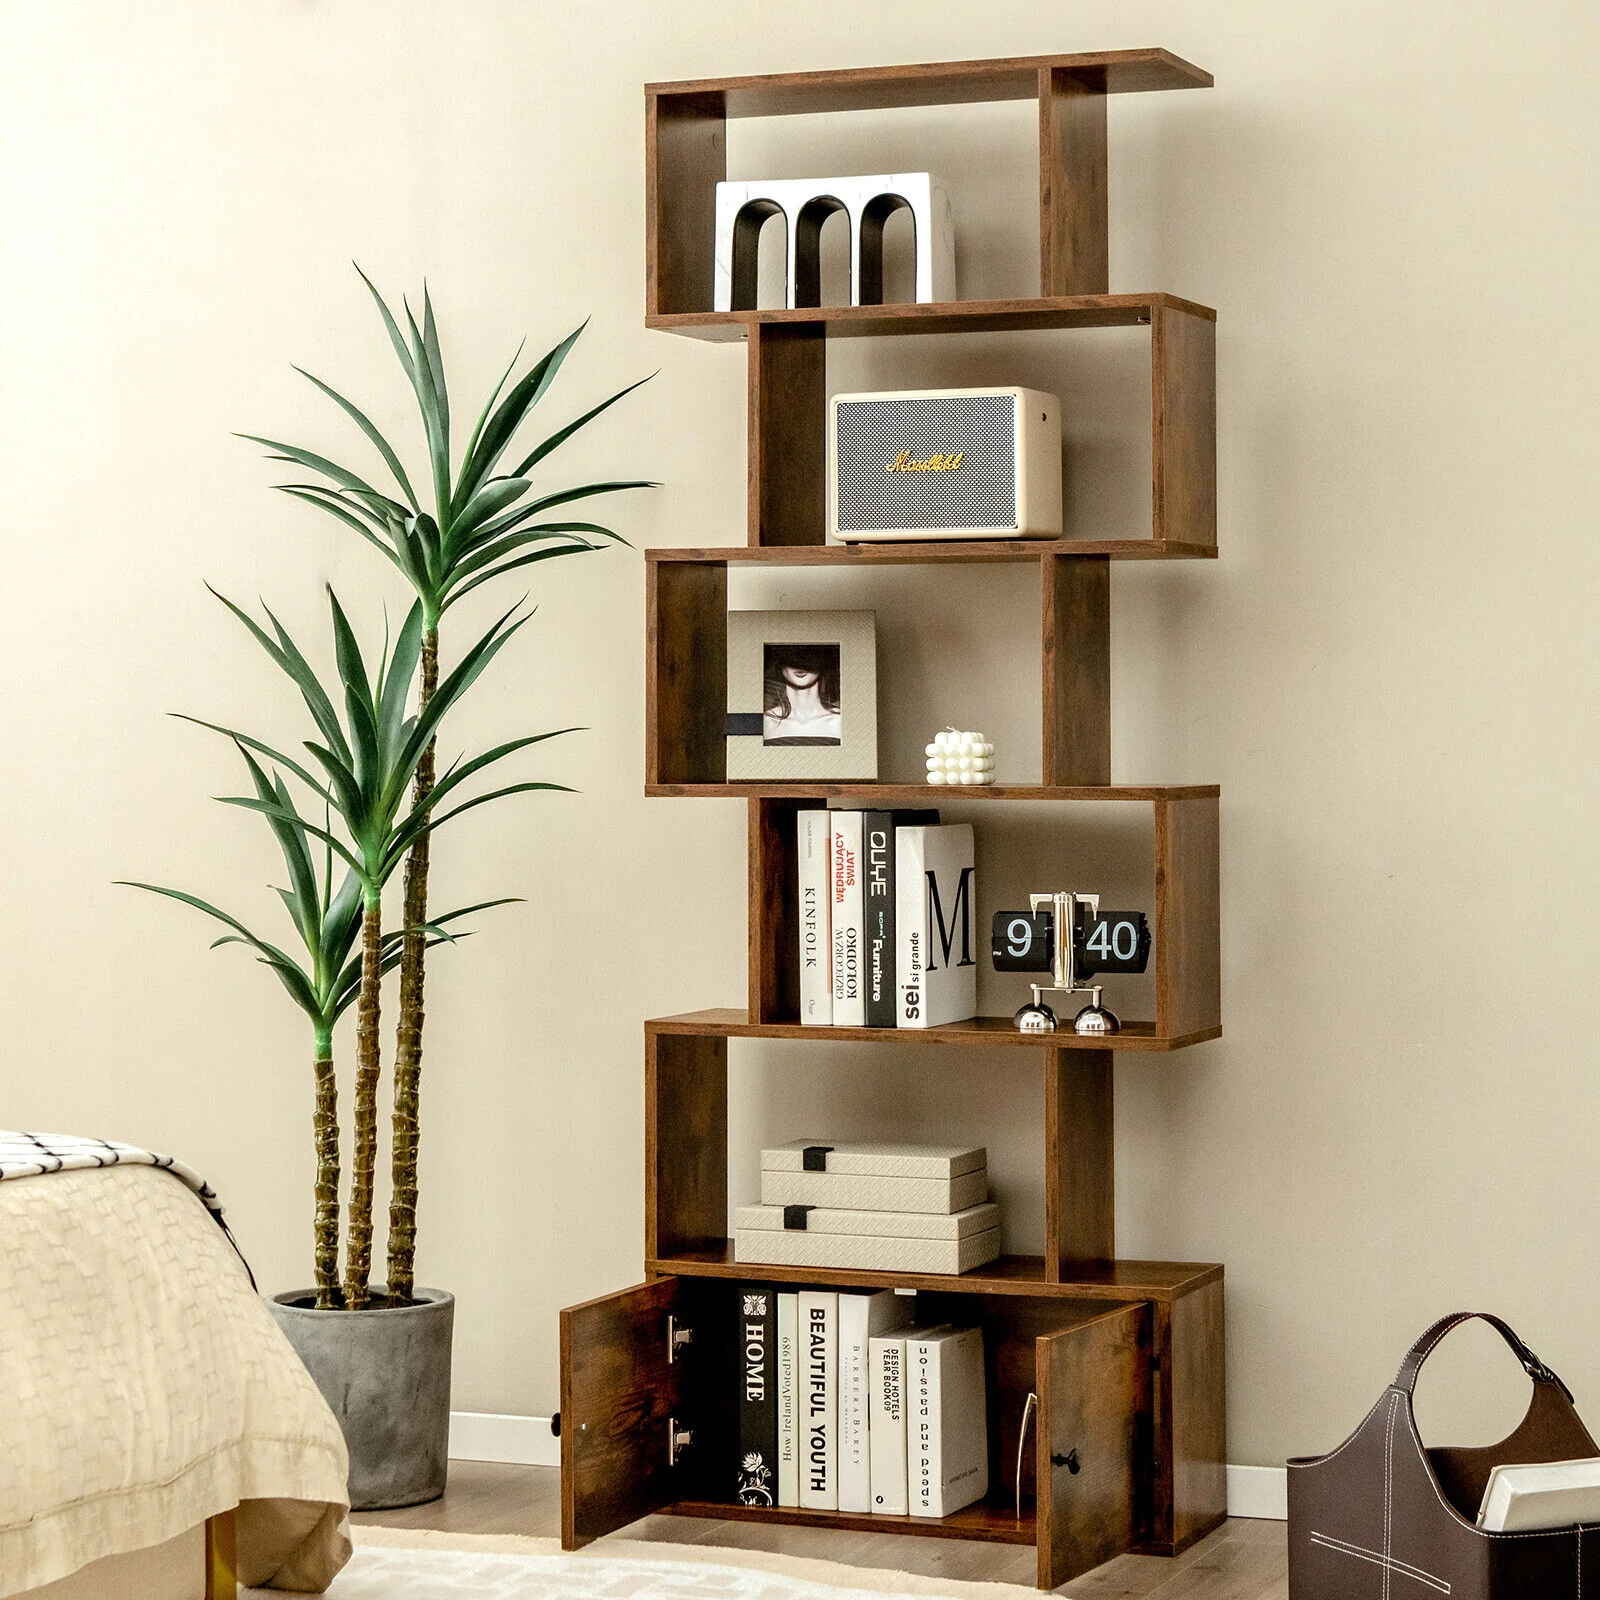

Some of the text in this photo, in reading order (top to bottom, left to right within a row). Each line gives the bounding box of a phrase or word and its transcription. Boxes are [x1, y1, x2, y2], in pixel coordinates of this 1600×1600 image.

[835, 832, 846, 903] WĘDRUJĄCY
[846, 850, 856, 886] ŚWIAT
[805, 887, 817, 968] KINFOLK
[925, 867, 976, 972] M
[1007, 918, 1138, 961] 9 40
[836, 942, 845, 1000] GRZEGORZ
[846, 927, 857, 999] KOŁODKO
[872, 939, 883, 1002] Furniture
[902, 932, 921, 1019] sei si grande
[745, 1323, 765, 1402] HOME
[883, 1348, 891, 1372] YEAR
[890, 1348, 900, 1421] DESIGN HOTELS
[810, 1308, 826, 1492] BEAUTIFUL YOUTH
[919, 1347, 930, 1507] speed and passion
[782, 1439, 792, 1461] How
